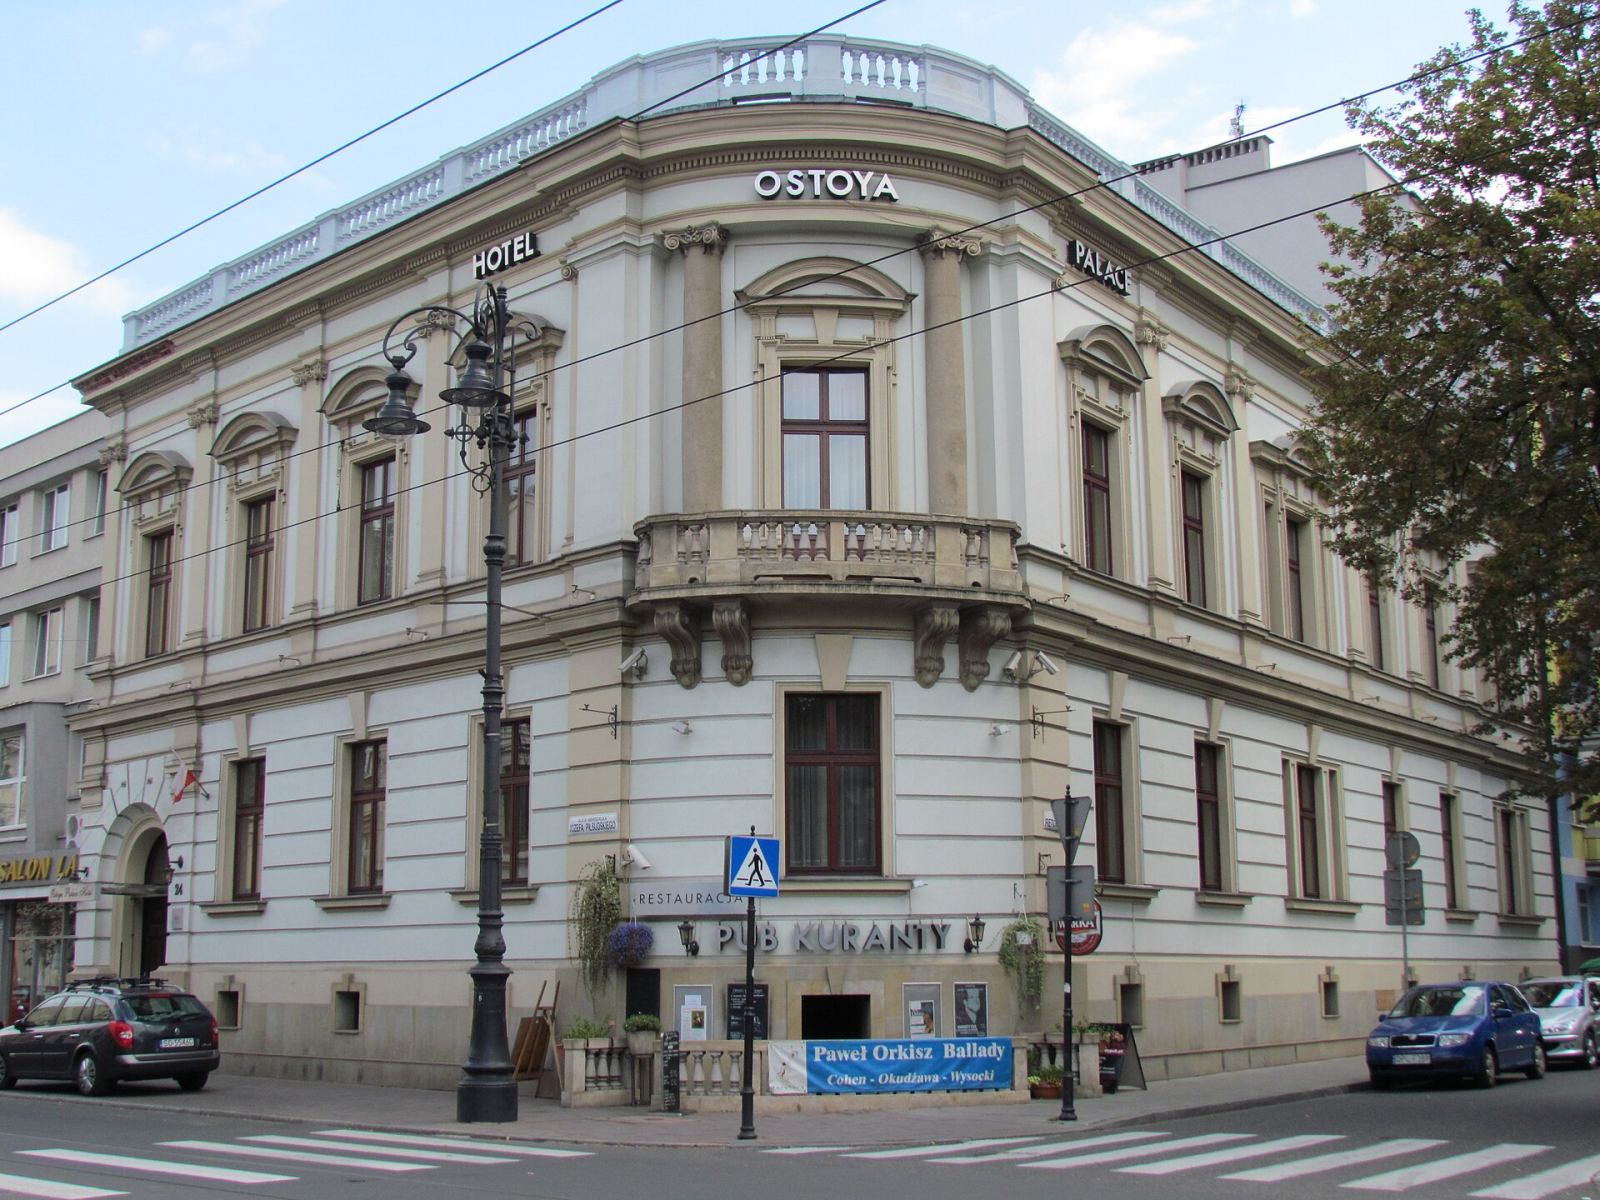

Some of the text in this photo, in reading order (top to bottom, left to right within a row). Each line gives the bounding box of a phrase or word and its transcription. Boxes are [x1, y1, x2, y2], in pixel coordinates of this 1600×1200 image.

[754, 169, 899, 201] OSTOYA
[472, 232, 537, 279] HOTEL
[1073, 239, 1131, 294] PALACE
[0, 857, 50, 882] SALON
[639, 893, 744, 905] RESTAURACJA
[718, 922, 951, 952] PUB KURANTY
[812, 1042, 1006, 1062] Paweł Orkisz Ballady
[827, 1073, 867, 1086] Cohen
[950, 1069, 995, 1086] Wysocki
